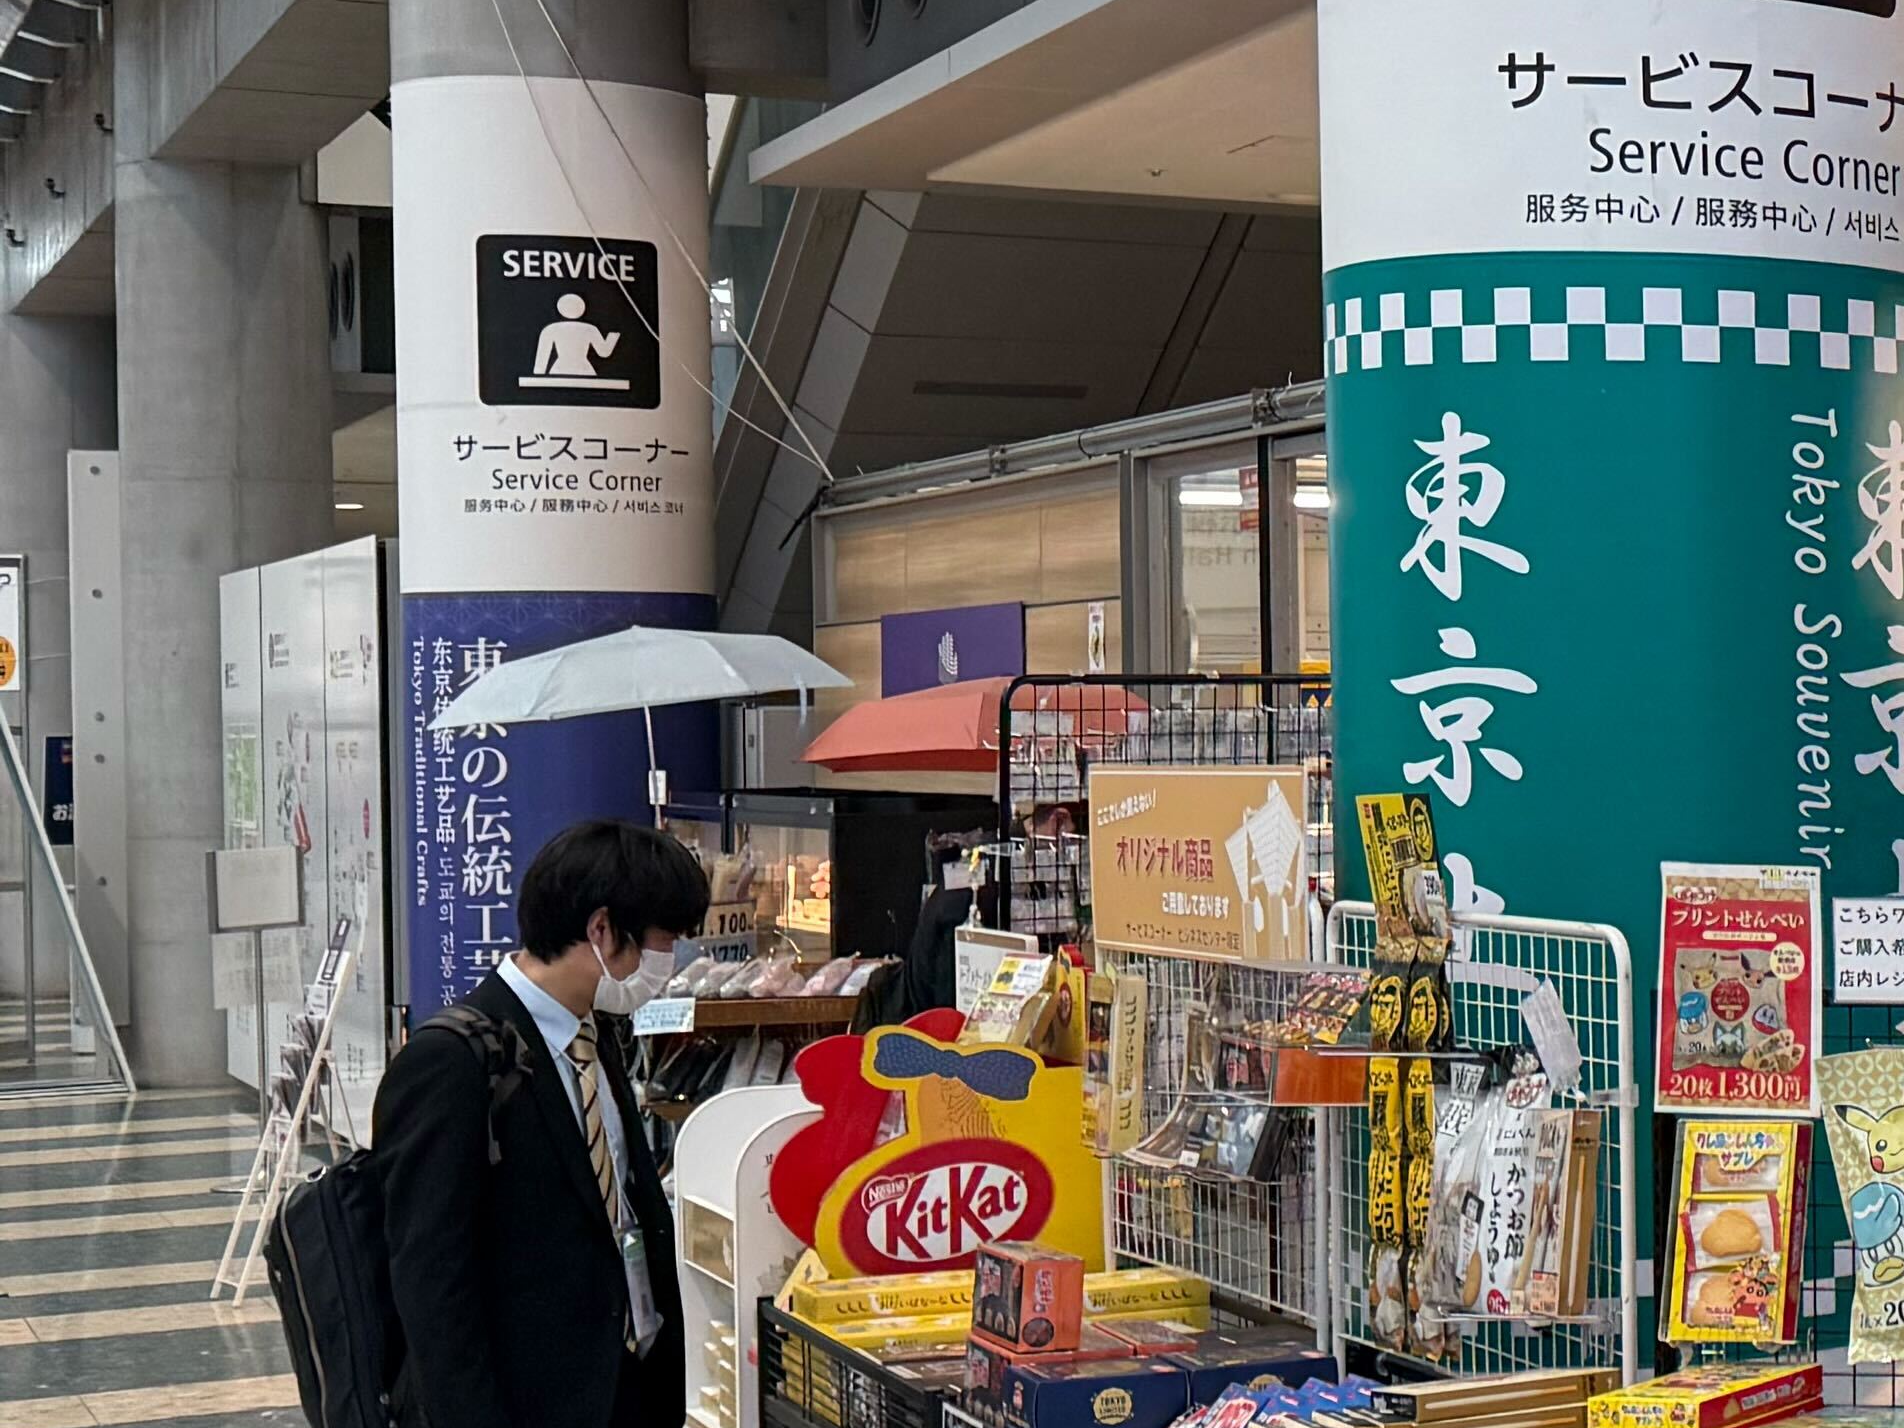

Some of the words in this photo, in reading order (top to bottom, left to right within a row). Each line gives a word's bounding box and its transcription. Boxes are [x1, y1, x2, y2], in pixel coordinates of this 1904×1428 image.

[1589, 127, 1764, 180] Service
[1782, 139, 1900, 197] Corner
[1525, 193, 1660, 225] 服务中心
[1695, 196, 1818, 234] 服務中心
[1844, 210, 1900, 242] 서비스
[502, 249, 635, 283] SERVICE
[454, 433, 689, 463] サービスコーナー
[492, 468, 578, 490] Service
[590, 470, 662, 492] Corner
[1785, 408, 1840, 575] Tokyo
[410, 635, 425, 706] Tokyo
[1792, 605, 1846, 870] Souvenir
[414, 710, 429, 835] Traditional
[415, 839, 429, 907] Crafts
[1116, 836, 1214, 880] オリジナル商品
[1672, 908, 1805, 928] プリントせんべい
[1718, 1072, 1801, 1100] 1,300円
[886, 1166, 1020, 1259] KitKat
